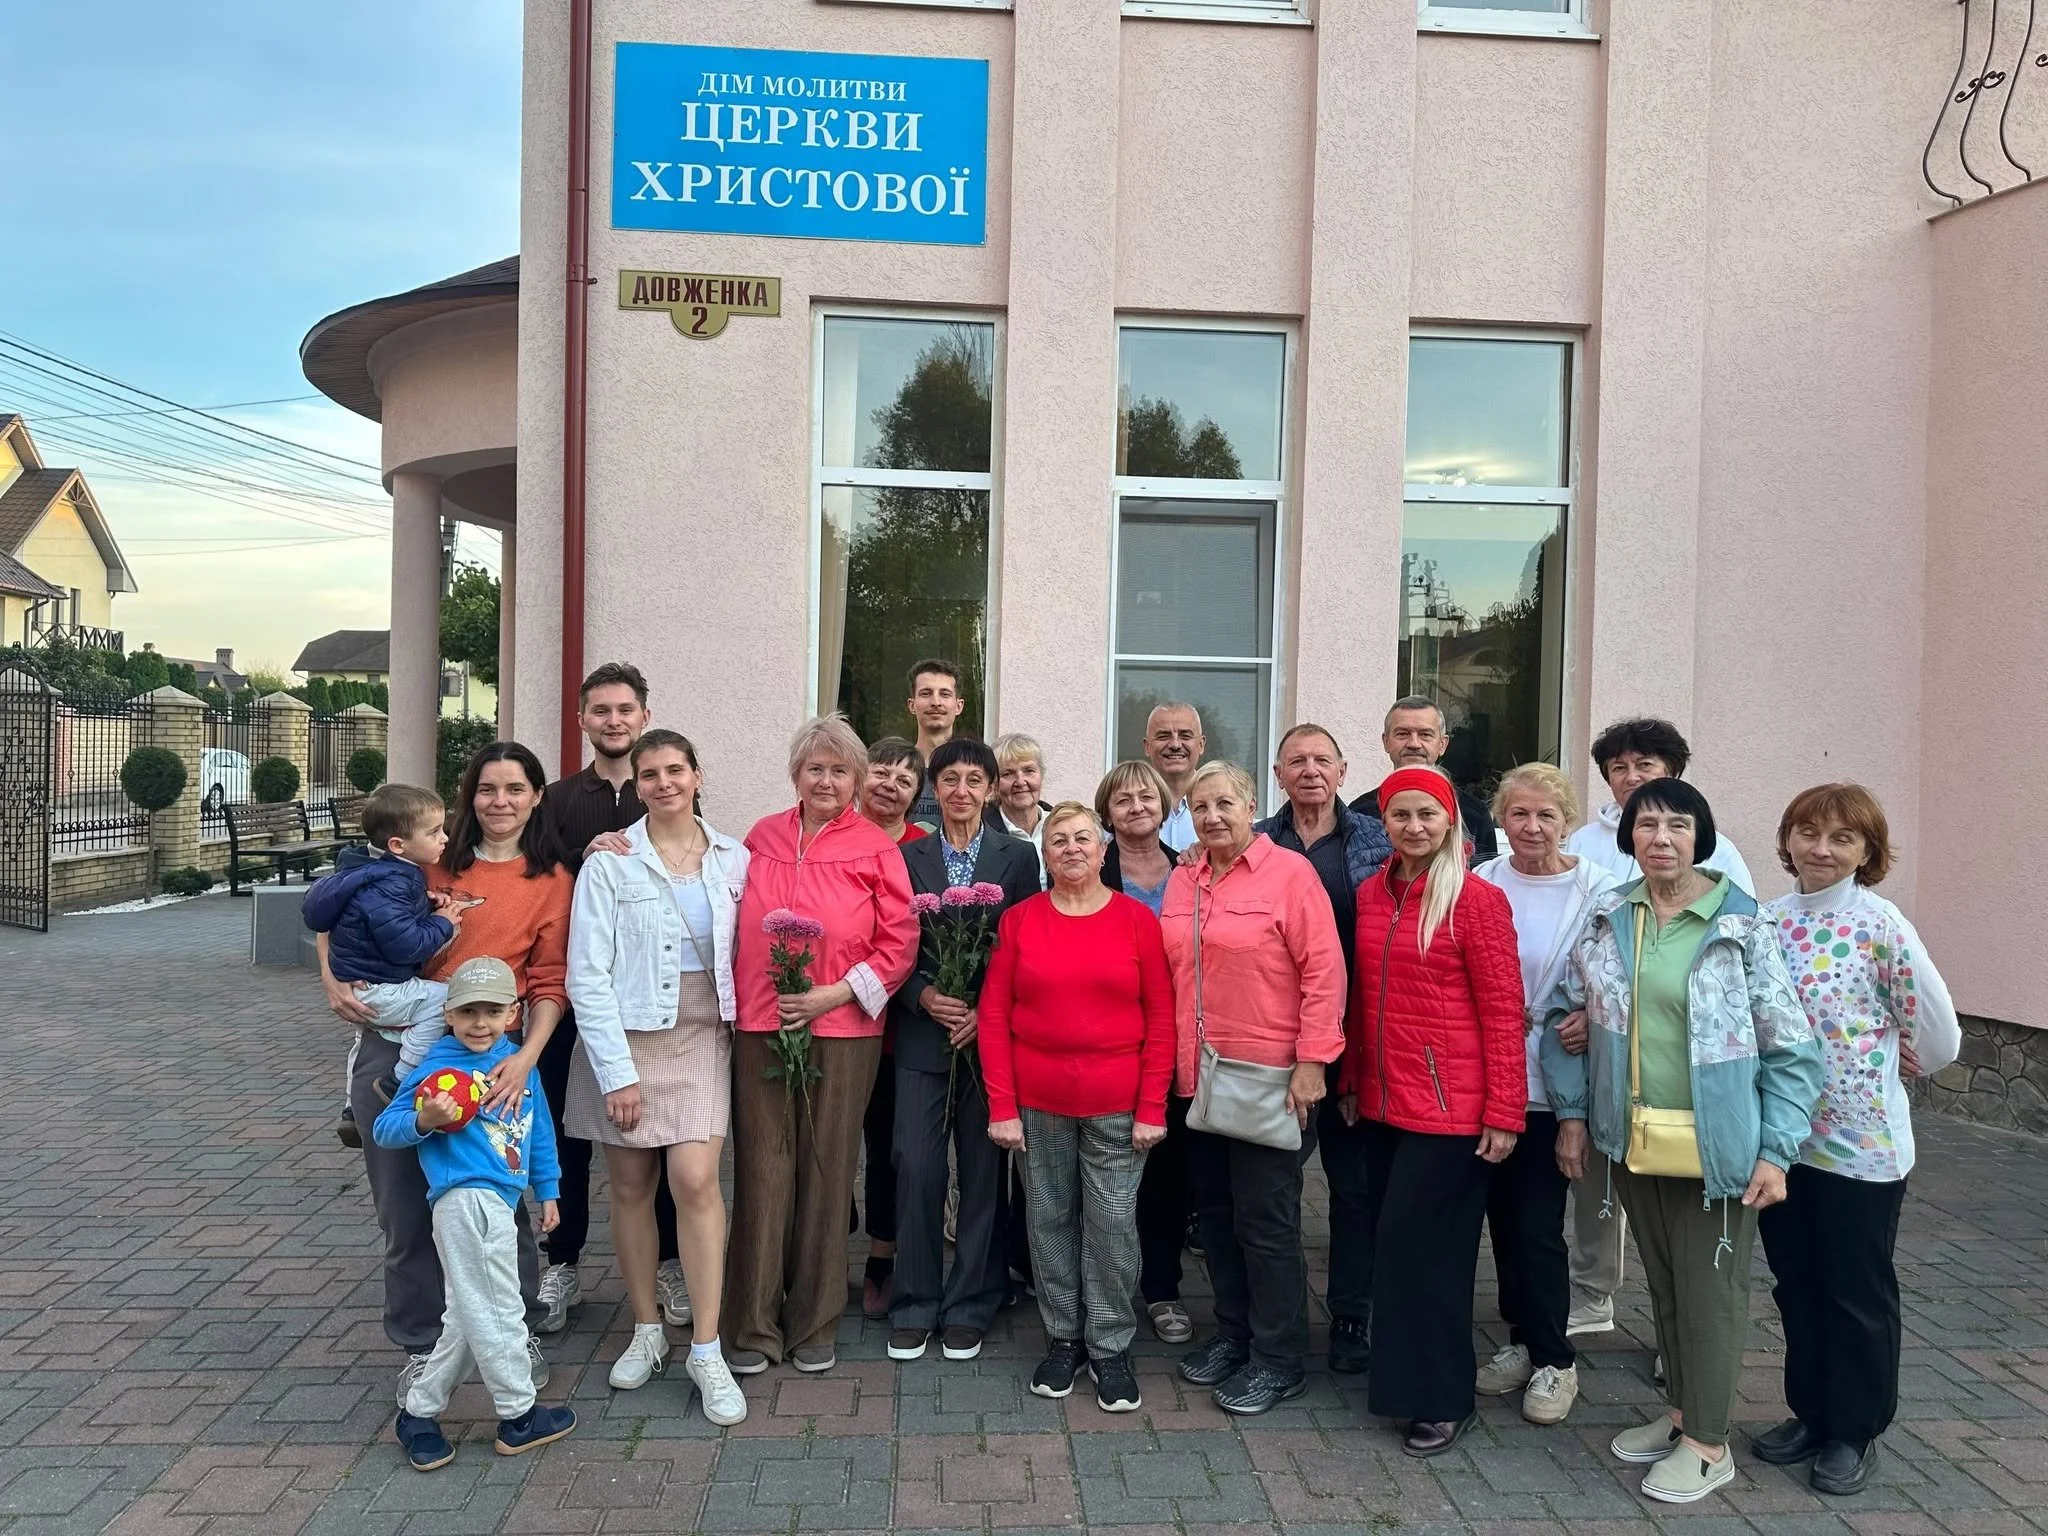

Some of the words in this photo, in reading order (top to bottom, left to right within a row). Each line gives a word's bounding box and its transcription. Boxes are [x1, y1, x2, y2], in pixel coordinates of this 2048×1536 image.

[698, 72, 754, 97] ДІМ
[762, 75, 907, 101] МОЛИТВИ
[681, 101, 923, 152] ЦЕРКВИ
[630, 161, 970, 216] ХРИСТОВОЇ
[632, 276, 768, 307] ДОВЖЕНКА
[692, 307, 708, 334] 2
